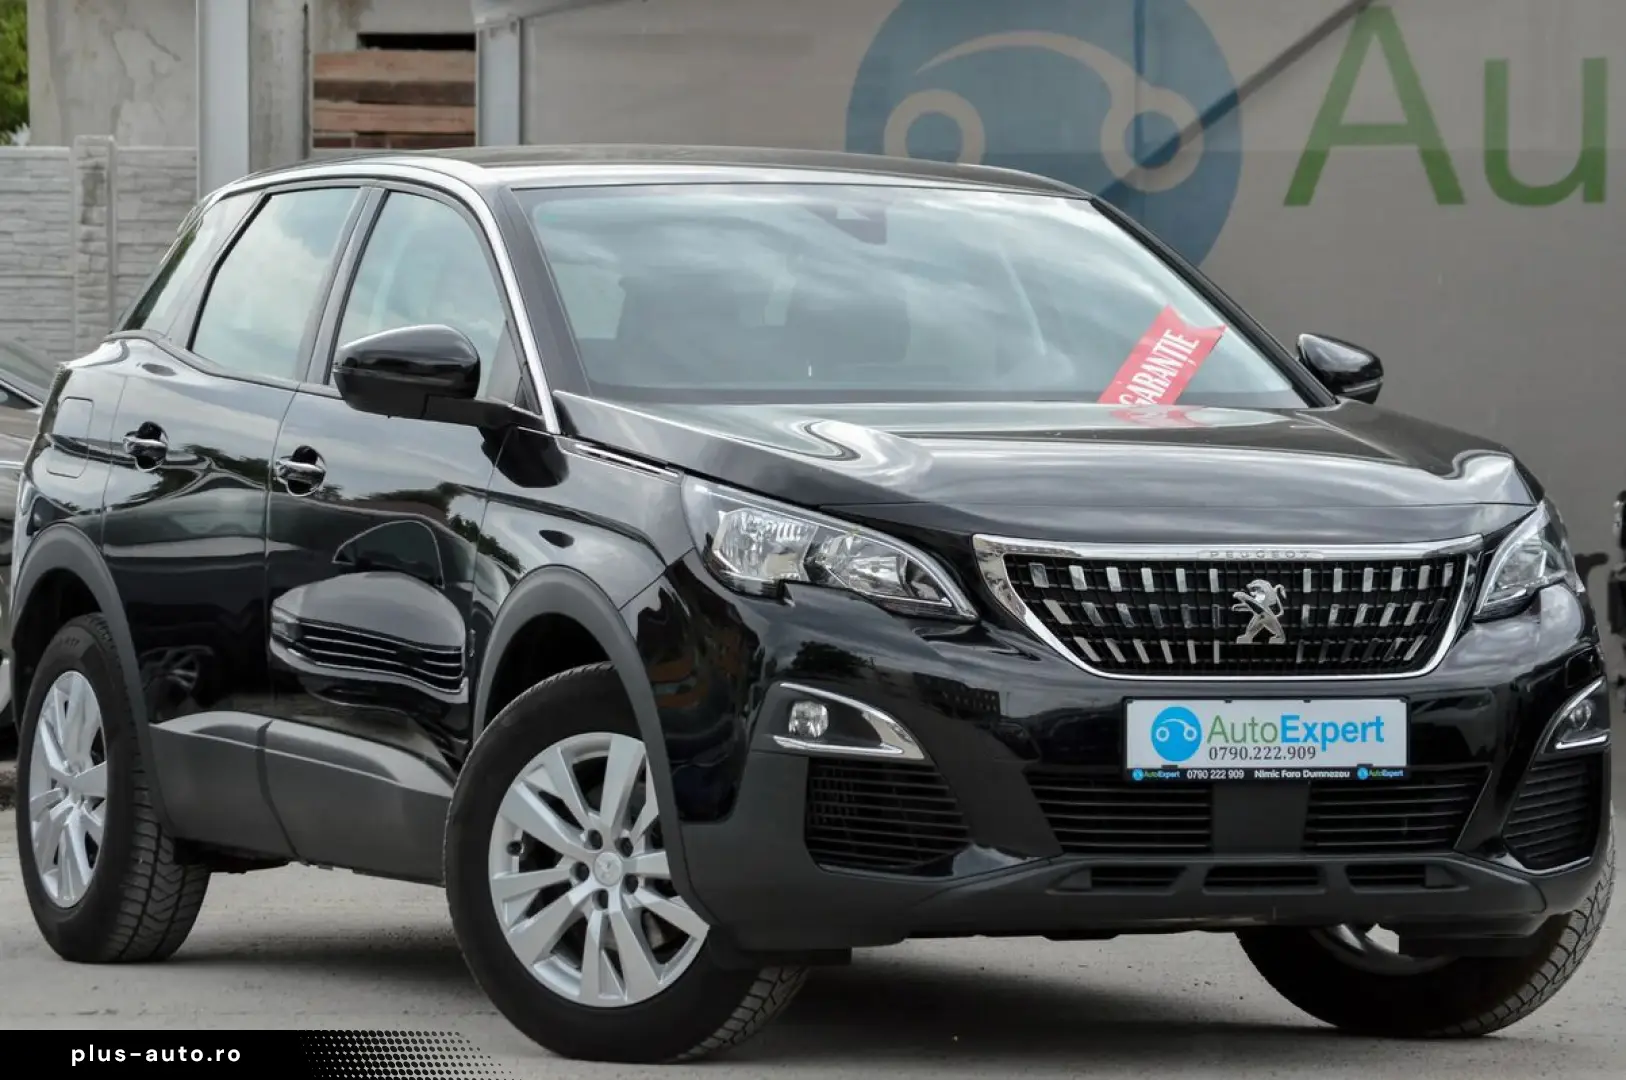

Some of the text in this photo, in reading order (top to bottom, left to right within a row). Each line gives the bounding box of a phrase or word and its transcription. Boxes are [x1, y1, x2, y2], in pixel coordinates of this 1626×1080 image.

[1283, 5, 1608, 207] Au
[1209, 550, 1309, 559] PEUGEOT
[1206, 715, 1385, 752] AutoExpert
[1208, 746, 1316, 761] 0790.222.909
[1144, 769, 1180, 779] AutoExpert
[1186, 769, 1209, 779] 0790
[1210, 769, 1227, 779] 222
[1228, 769, 1245, 779] 909
